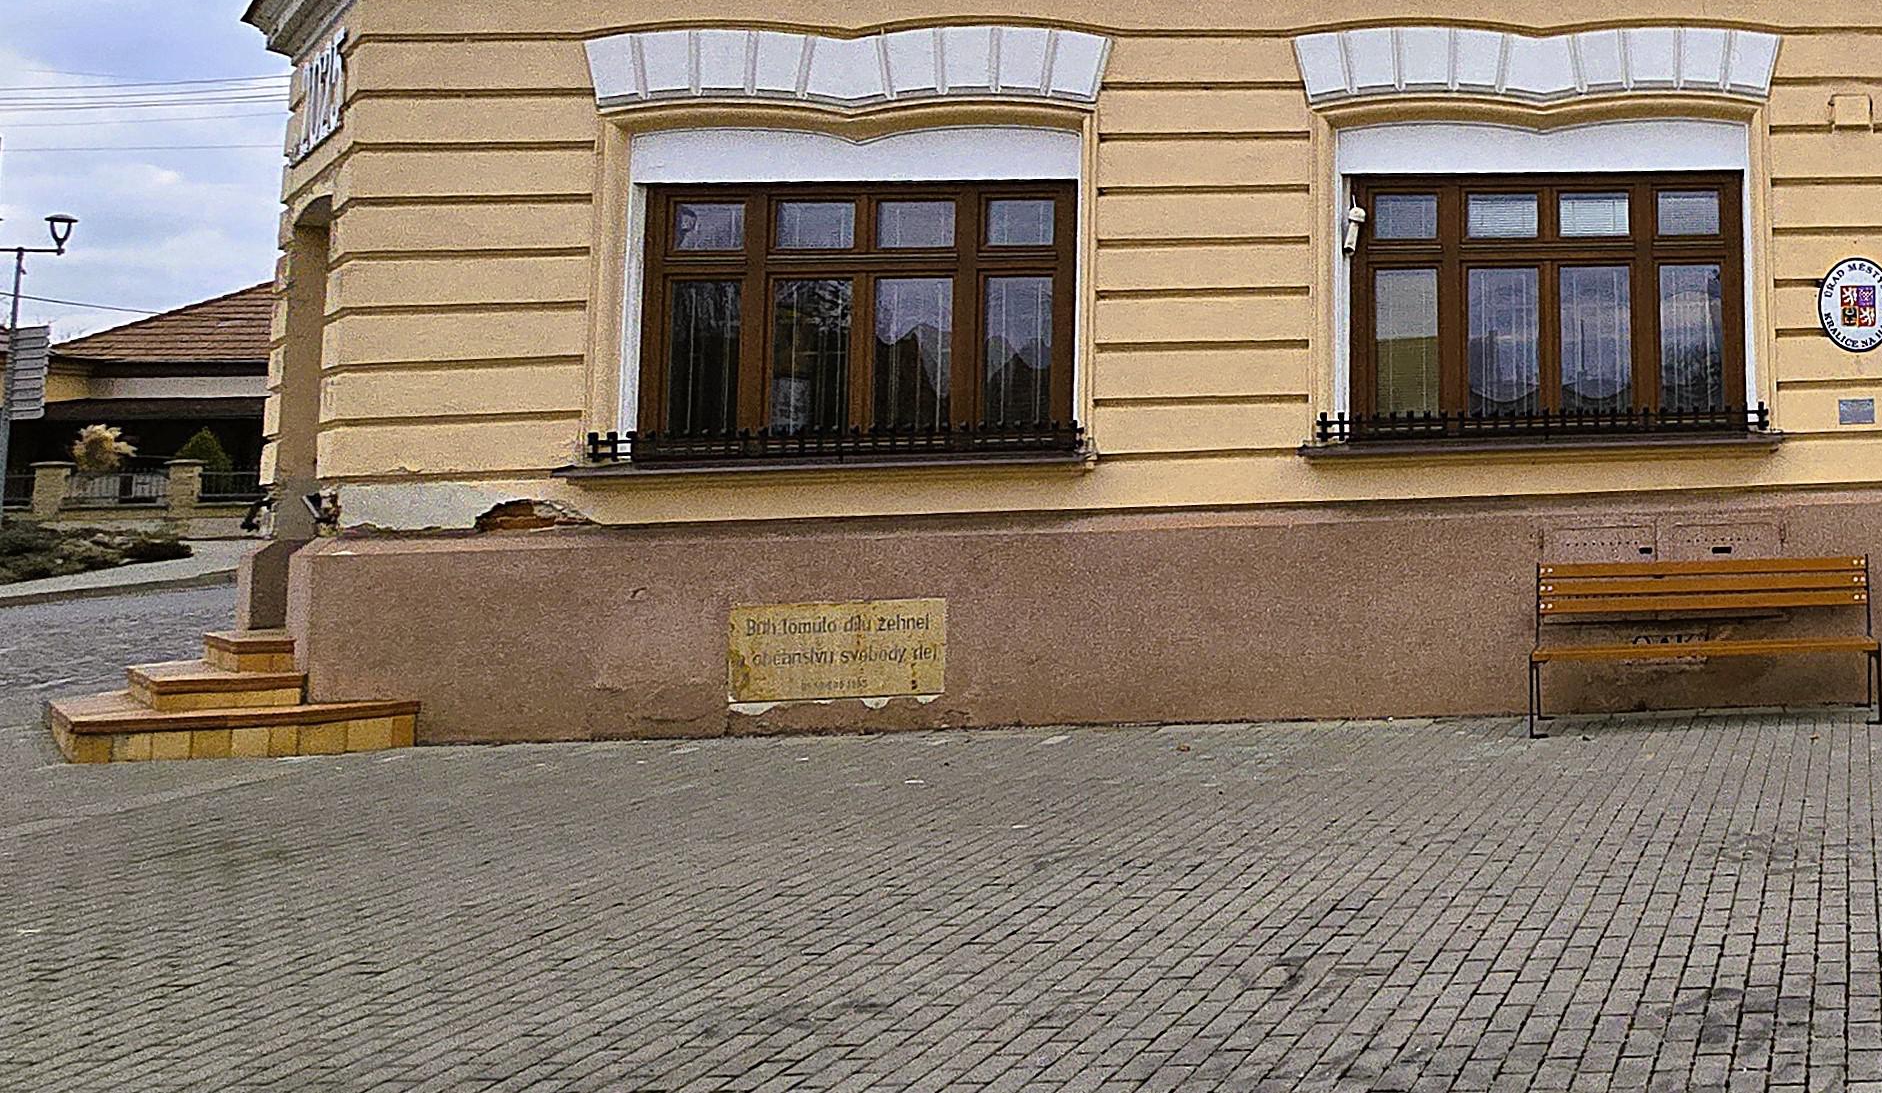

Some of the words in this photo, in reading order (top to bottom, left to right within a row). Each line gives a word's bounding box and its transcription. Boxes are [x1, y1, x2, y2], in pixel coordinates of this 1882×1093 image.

[1824, 312, 1859, 348] KRALICE
[1861, 337, 1876, 348] NA
[840, 645, 907, 665] svobody
